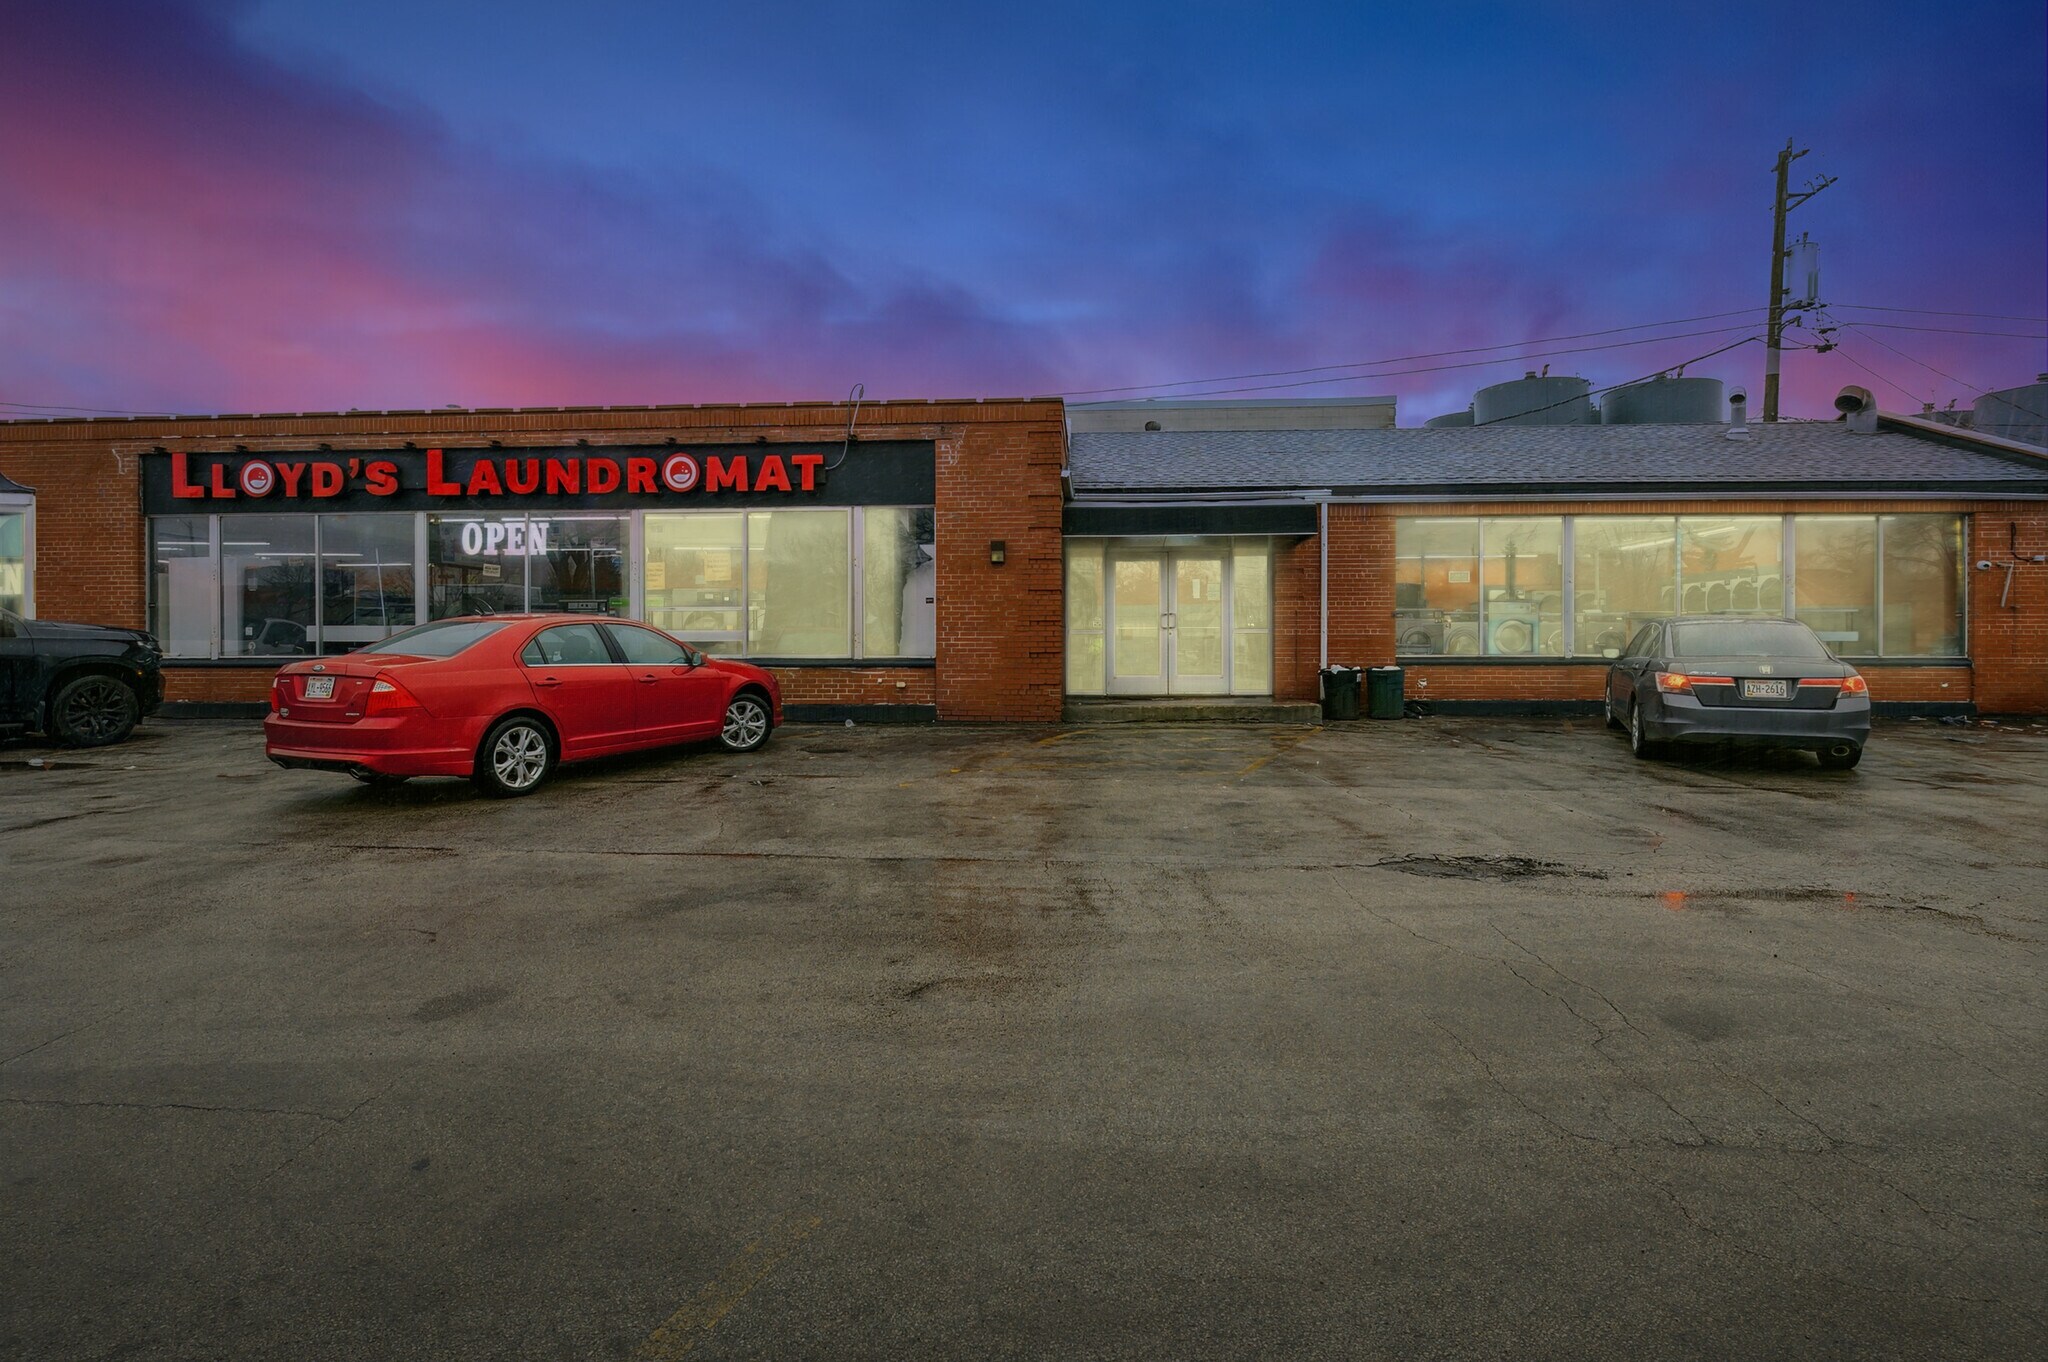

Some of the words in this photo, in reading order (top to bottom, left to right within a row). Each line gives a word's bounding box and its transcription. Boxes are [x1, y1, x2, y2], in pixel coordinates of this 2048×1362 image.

[171, 453, 399, 498] LLOYD'S
[426, 449, 824, 496] LAUNDROMAT
[462, 522, 550, 556] OPEN
